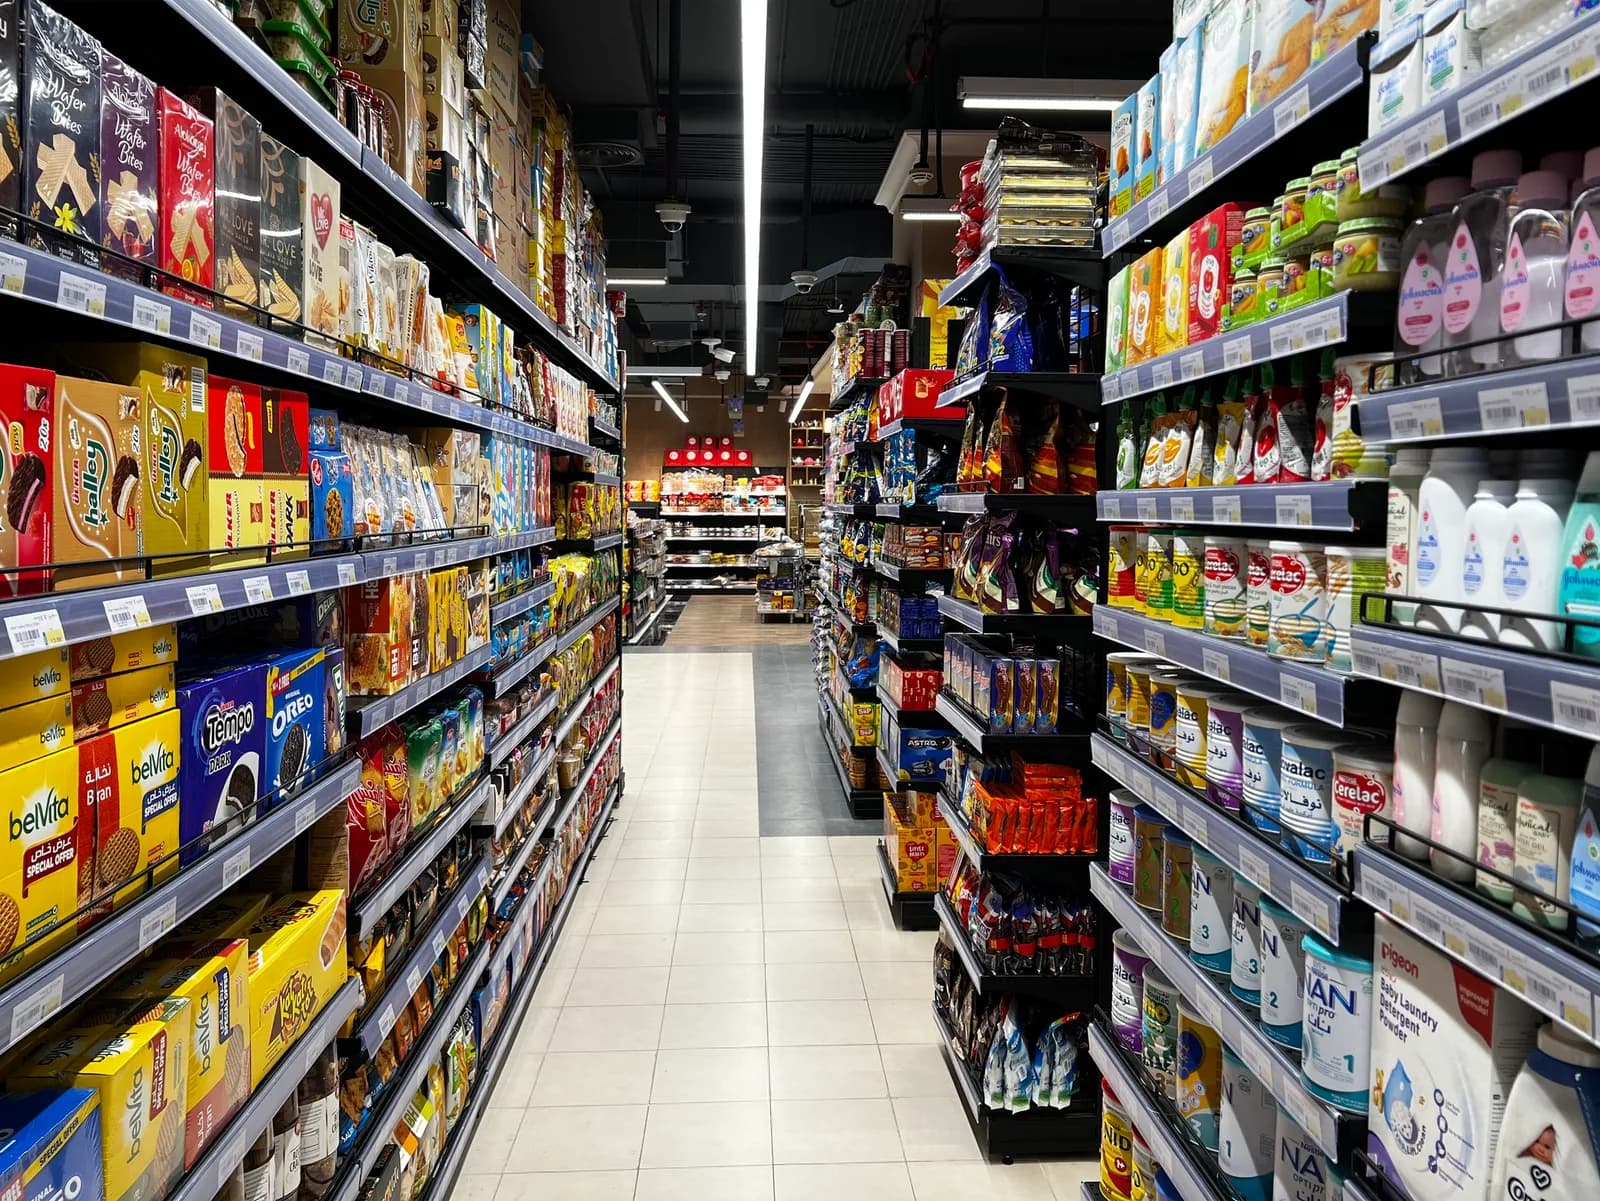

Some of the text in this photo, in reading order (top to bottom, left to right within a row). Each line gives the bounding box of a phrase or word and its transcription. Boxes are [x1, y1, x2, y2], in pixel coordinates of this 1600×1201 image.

[47, 75, 87, 111] Wafer
[51, 99, 82, 135] Bites
[115, 112, 147, 150] Wafer
[118, 140, 144, 171] Bites
[177, 148, 204, 182] Wafer
[233, 215, 254, 237] LOVE
[272, 236, 297, 259] LOVE
[309, 257, 323, 283] LOVE
[160, 424, 178, 503] halley
[72, 457, 80, 505] ÜLKER
[84, 438, 108, 526] halley
[285, 493, 294, 550] DARK
[152, 639, 172, 655] belVita
[33, 668, 61, 687] belVita
[150, 689, 169, 705] belVita
[207, 702, 254, 748] Tempo
[272, 694, 313, 737] OREO
[40, 725, 66, 744] belVita
[85, 763, 111, 784] نخالة
[131, 743, 174, 785] belVita
[209, 751, 231, 775] DARK
[87, 787, 112, 806] Bran
[144, 791, 178, 817] SPECIAL OFFER
[1334, 780, 1380, 804] Cerelac
[9, 785, 69, 841] belVita
[27, 847, 74, 878] SPECIAL OFFER
[1201, 924, 1210, 939] 3
[1249, 958, 1258, 974] 3
[1380, 941, 1419, 979] pigeon
[1269, 992, 1278, 1008] 2
[1379, 993, 1420, 1038] Detergent
[1380, 977, 1439, 1033] Baby Laundry
[197, 991, 210, 1077] belVita
[1379, 1011, 1408, 1044] Powder
[1343, 1054, 1355, 1073] 1
[127, 1066, 144, 1163] belVita
[39, 1116, 80, 1167] SPECIAL OFFER
